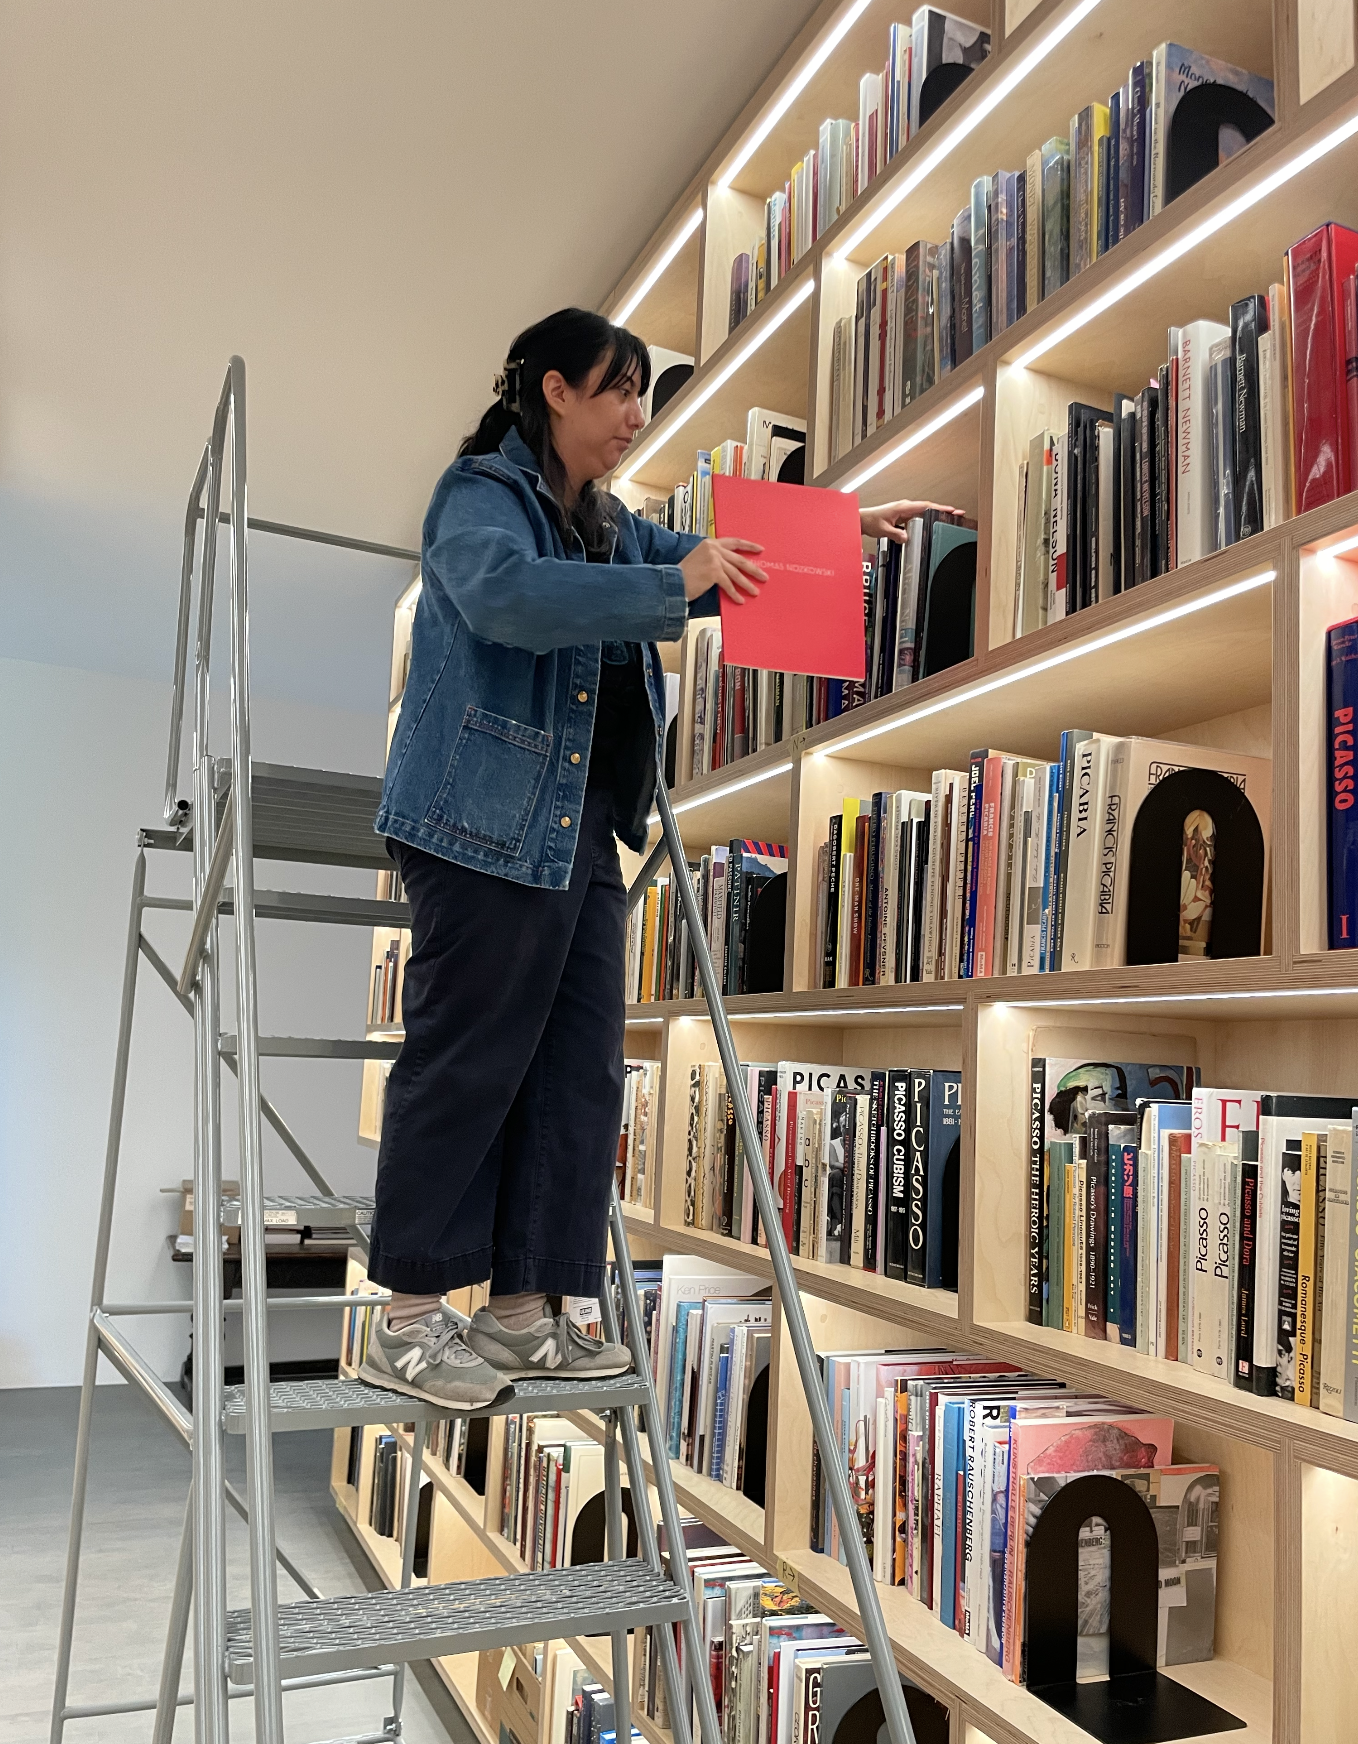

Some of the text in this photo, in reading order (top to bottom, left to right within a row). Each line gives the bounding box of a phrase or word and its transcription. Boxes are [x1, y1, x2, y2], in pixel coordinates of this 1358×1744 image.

[1181, 340, 1191, 475] BARNETT NEWMAN
[1237, 353, 1247, 433] Barnett Newman
[970, 765, 980, 791] JOEL
[1334, 706, 1355, 810] PICASSO
[960, 787, 968, 845] BEVERLY
[1076, 751, 1093, 840] PICABIA
[1098, 795, 1121, 916] FRANCIS PICABIA
[1340, 915, 1350, 938] I
[792, 1071, 868, 1092] PICAS
[871, 1079, 880, 1099] THE
[763, 1100, 771, 1141] PICASSO
[892, 1082, 907, 1198] PICASSO CUBISM
[1193, 1097, 1203, 1139] EROS
[909, 1078, 926, 1250] PICASSO
[1029, 1083, 1042, 1294] PICASSO THE HEROIC YEARS
[1123, 1152, 1134, 1198] ピカソ展
[866, 1178, 874, 1215] PICASSO
[1242, 1177, 1255, 1265] Picasso and Dora
[1088, 1211, 1097, 1247] Drawings
[1195, 1207, 1209, 1273] Picasso
[1214, 1212, 1230, 1280] Picasso
[676, 1284, 721, 1295] Ken Price
[1240, 1288, 1249, 1338] James Lord
[965, 1401, 976, 1562] ROBERT RAUSCHENBERG
[783, 1561, 788, 1579] R
[1004, 1438, 1018, 1664] KUNSTHALLE BERLIN RAUSCHENBERG
